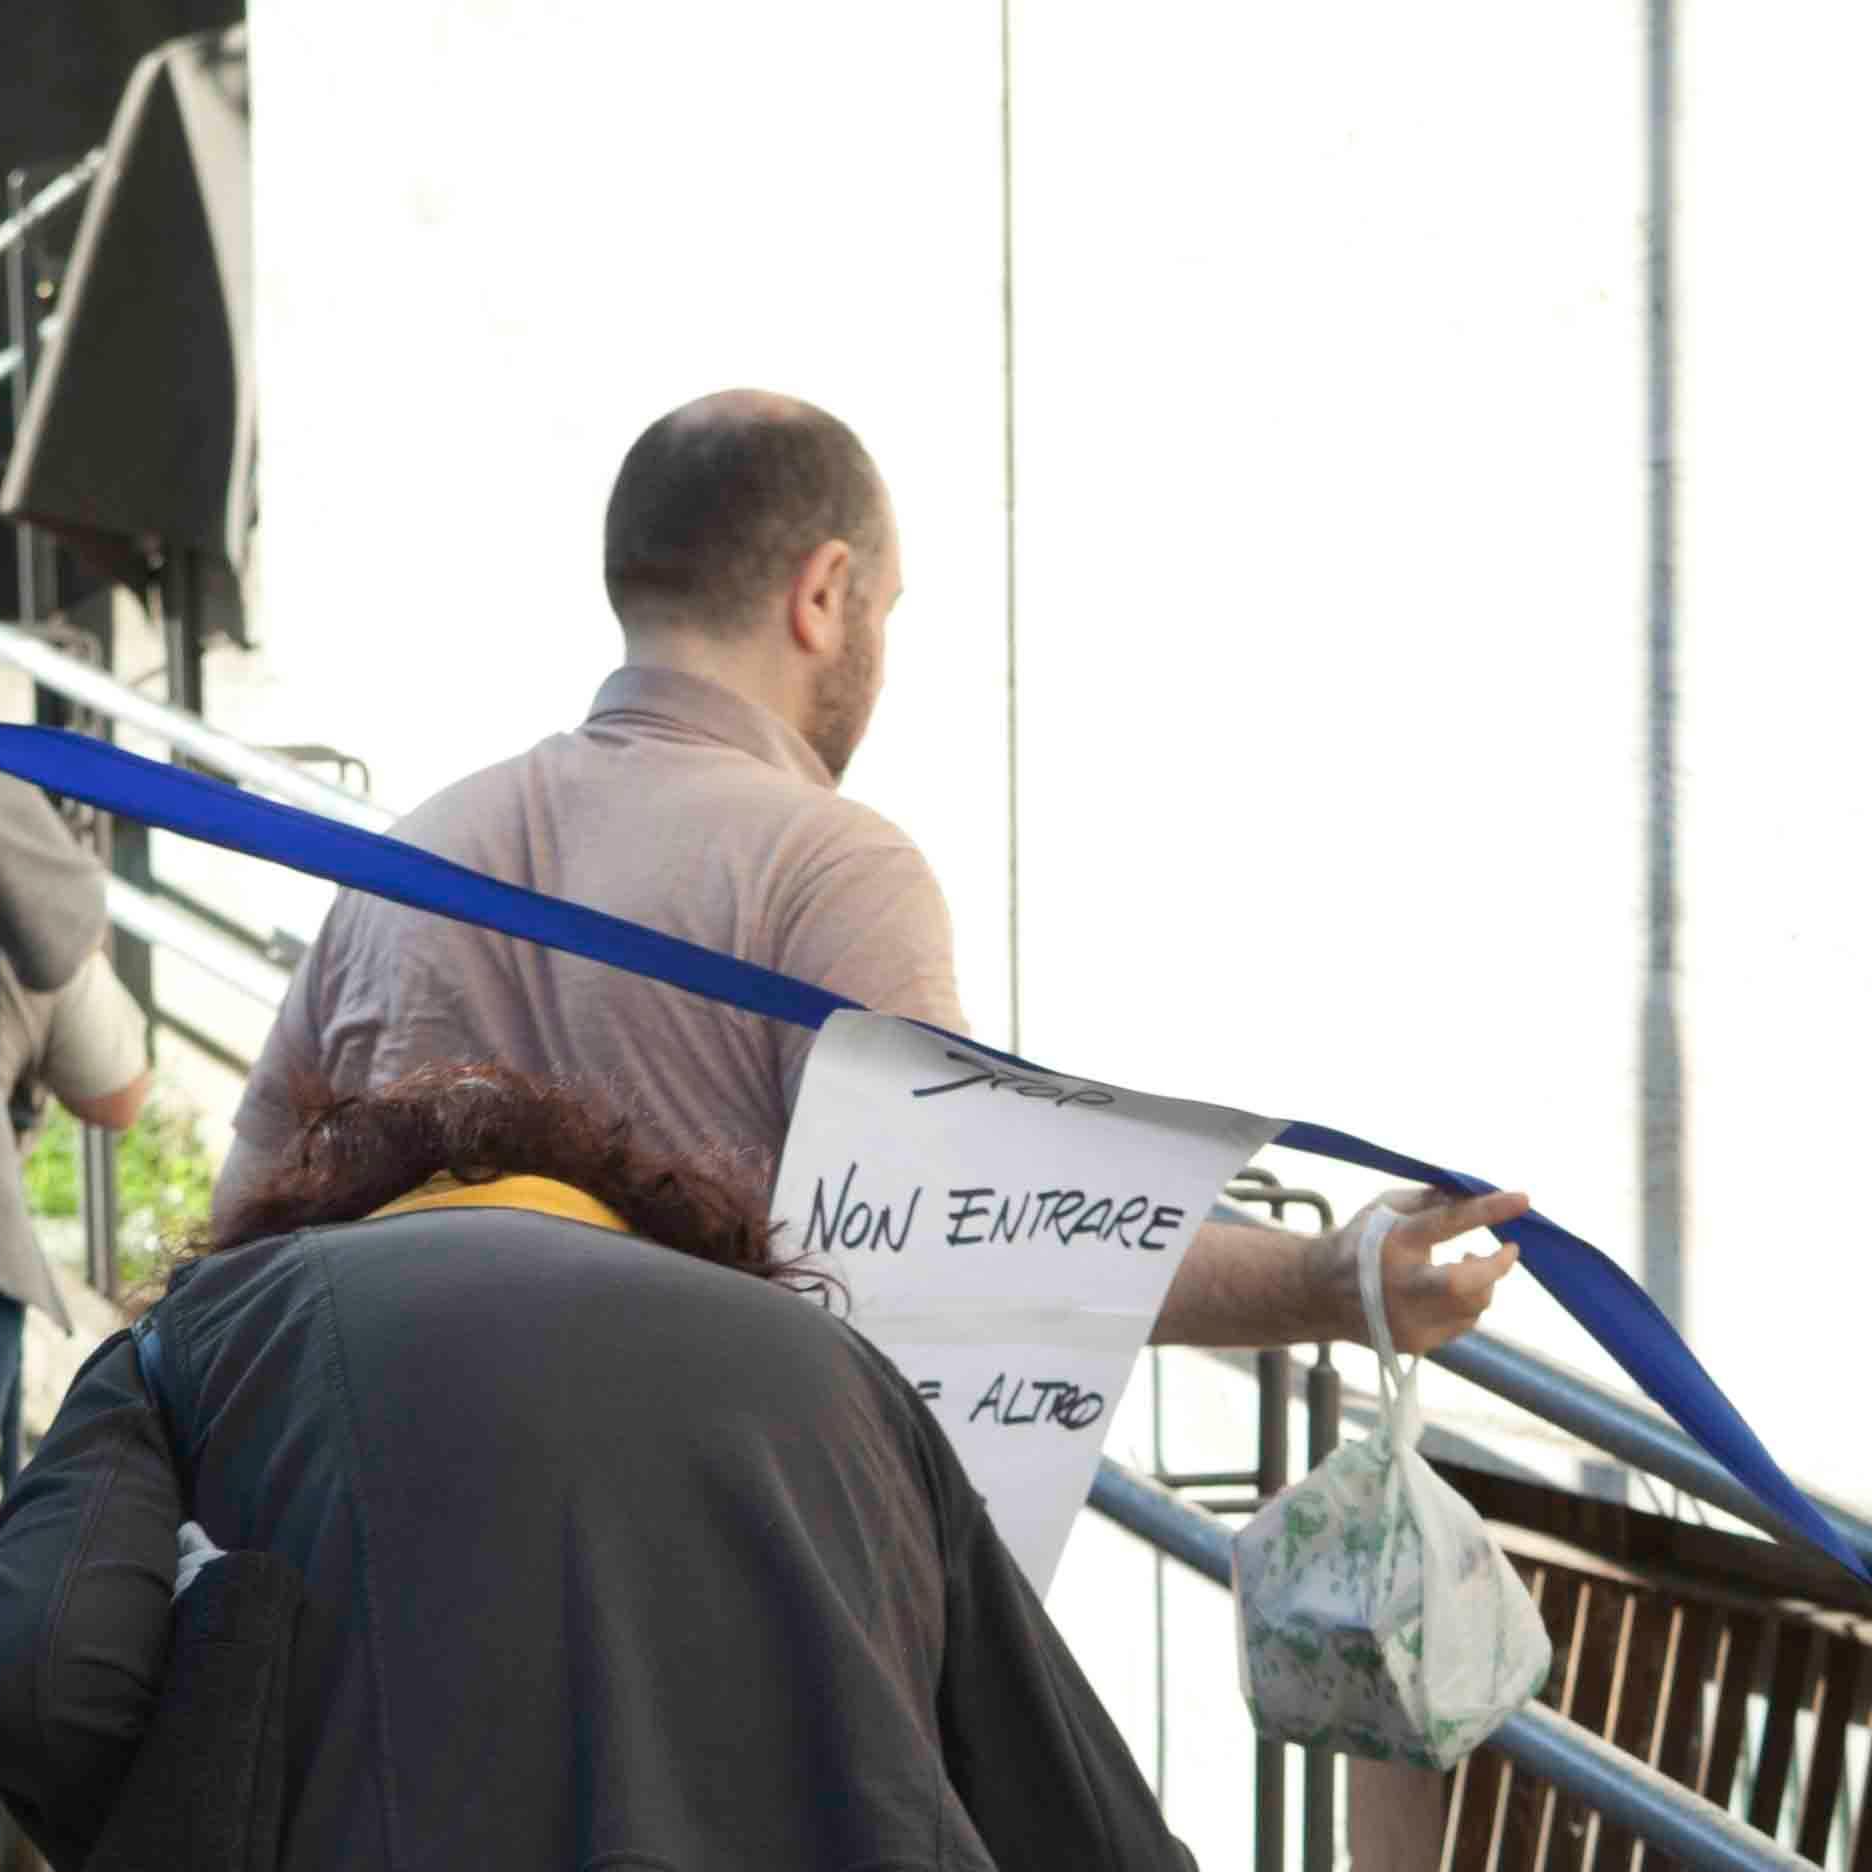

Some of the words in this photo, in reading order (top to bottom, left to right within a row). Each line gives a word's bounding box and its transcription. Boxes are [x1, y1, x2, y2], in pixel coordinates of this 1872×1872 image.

[801, 1161, 924, 1254] NON
[944, 1187, 1186, 1252] ENTRARE
[967, 1372, 1105, 1430] ALTRO
